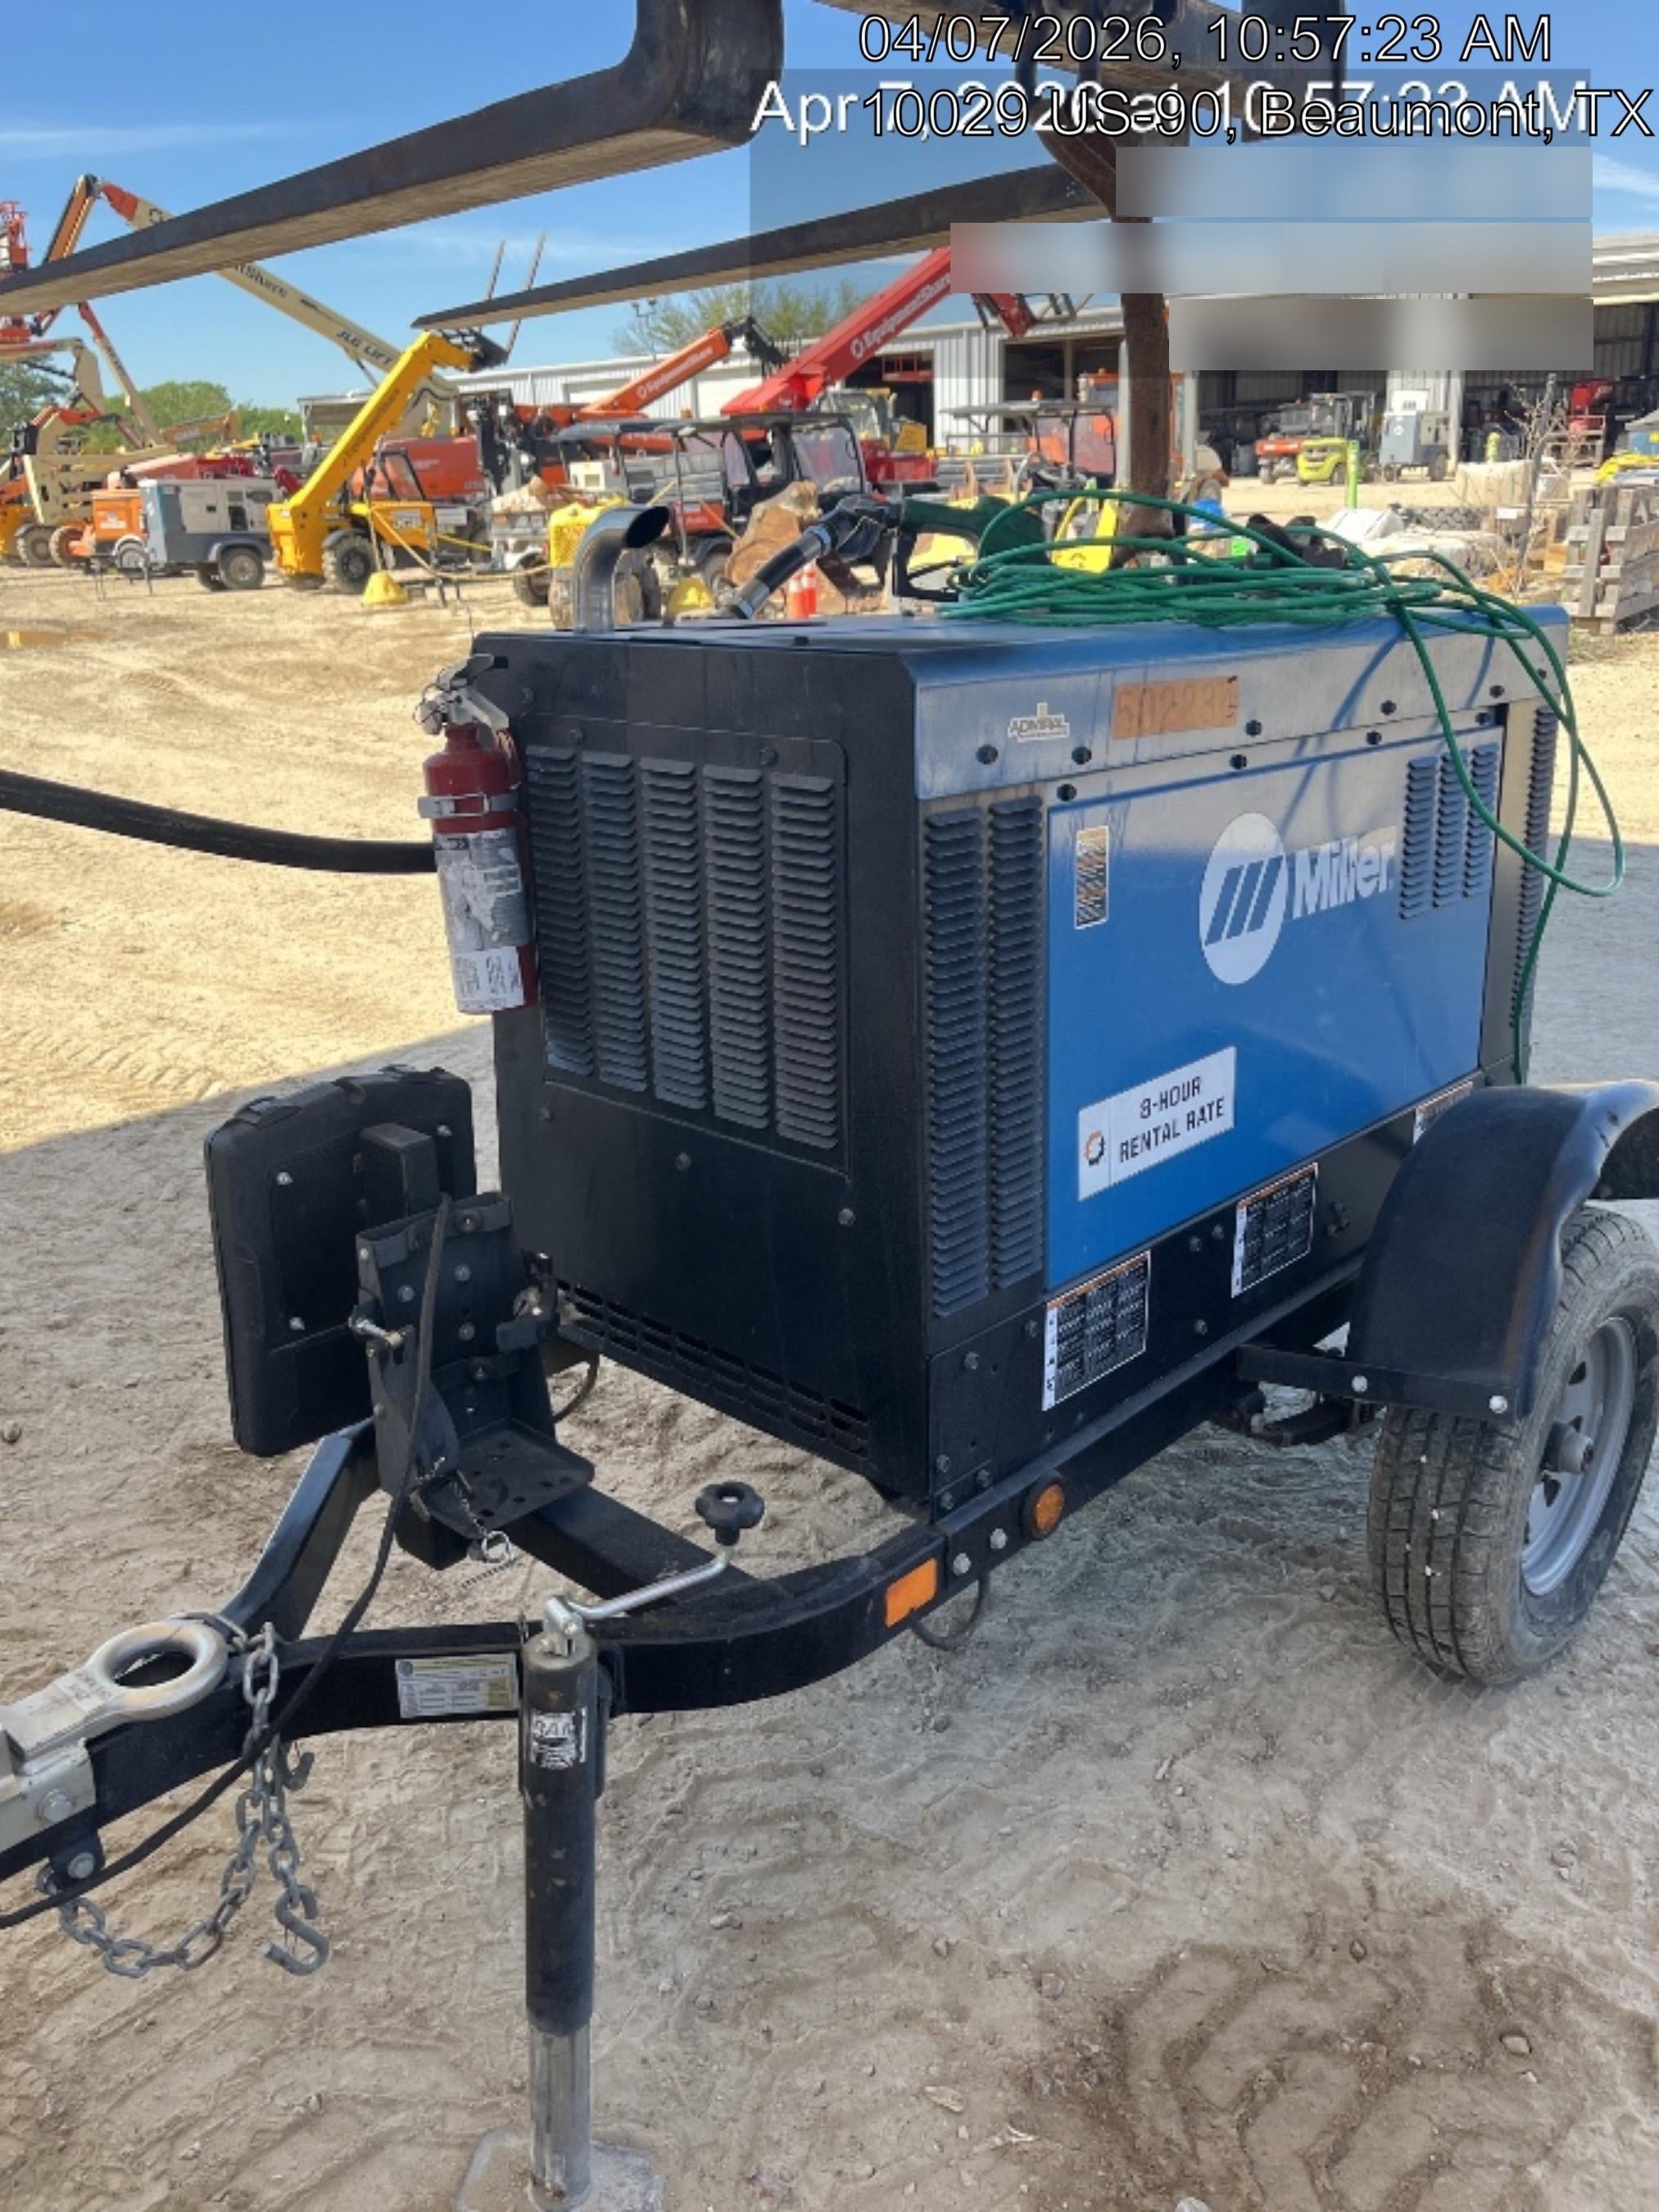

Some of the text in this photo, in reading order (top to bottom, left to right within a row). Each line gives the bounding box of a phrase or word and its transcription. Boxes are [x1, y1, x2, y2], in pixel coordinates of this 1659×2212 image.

[1292, 836, 1395, 920] Miller
[1119, 1096, 1225, 1163] RENTAL RATE
[1140, 1076, 1201, 1119] 8-HOUR
